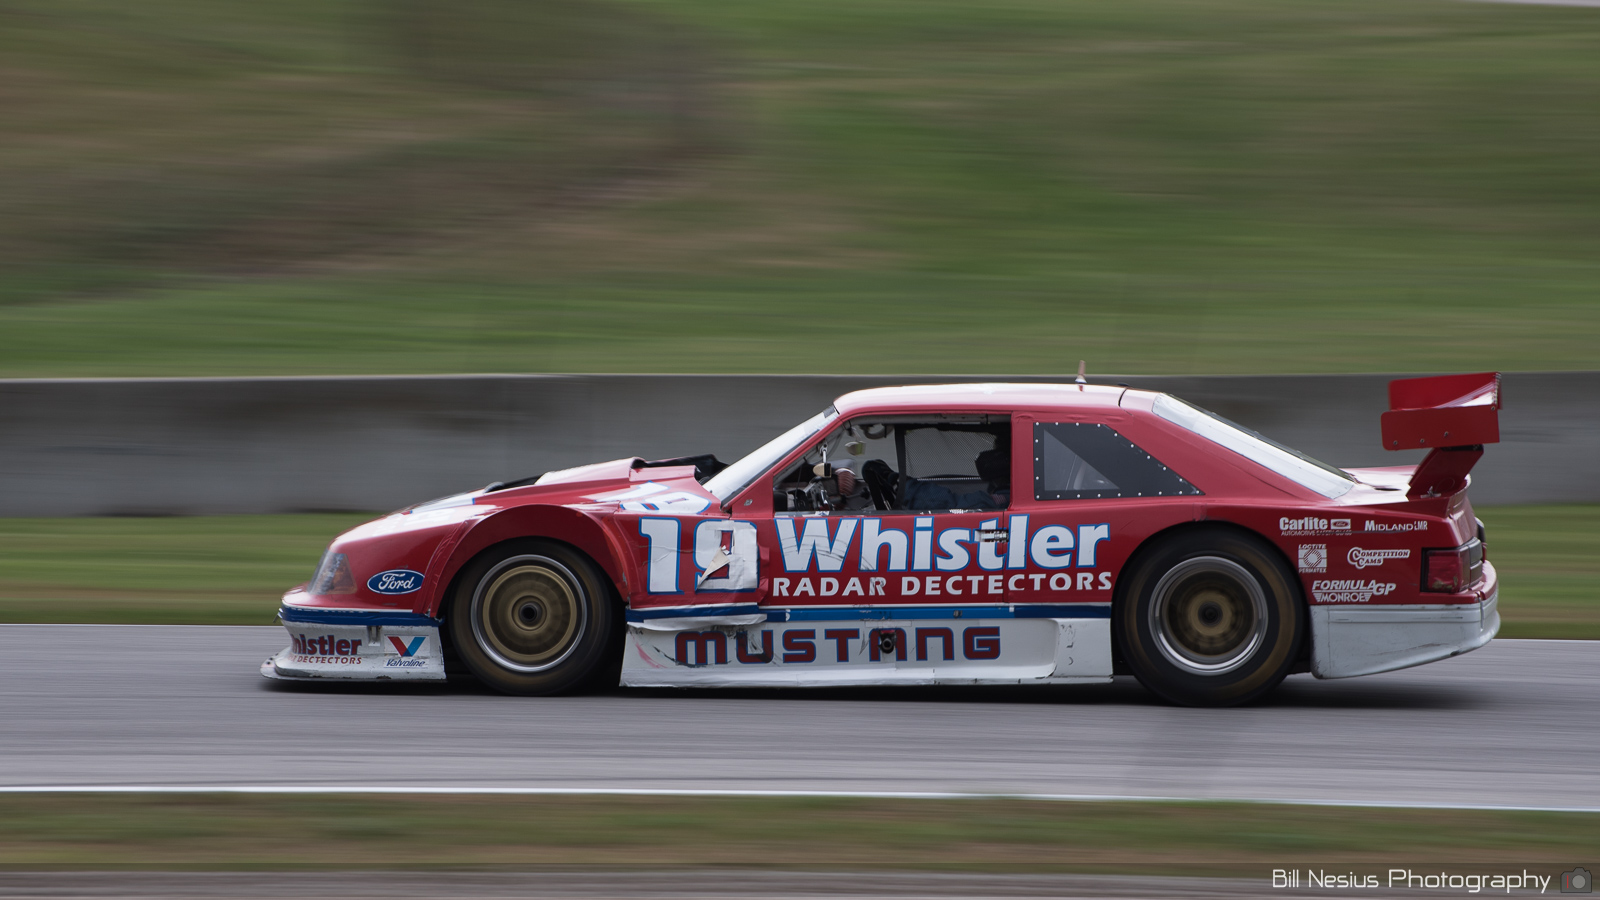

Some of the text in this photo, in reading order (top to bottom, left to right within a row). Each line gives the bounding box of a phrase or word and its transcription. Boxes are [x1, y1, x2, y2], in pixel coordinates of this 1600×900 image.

[1280, 517, 1328, 530] Carlite
[774, 514, 1111, 573] Whistler
[378, 573, 415, 590] Ford
[773, 572, 1112, 597] RADAR DECTECTORS
[1312, 580, 1397, 595] FORMULA GP
[1320, 592, 1366, 602] MONROE
[290, 633, 362, 656] histler
[674, 626, 1001, 666] MUSTANG
[298, 656, 362, 665] DECTECTORS
[386, 658, 426, 667] Valvoline
